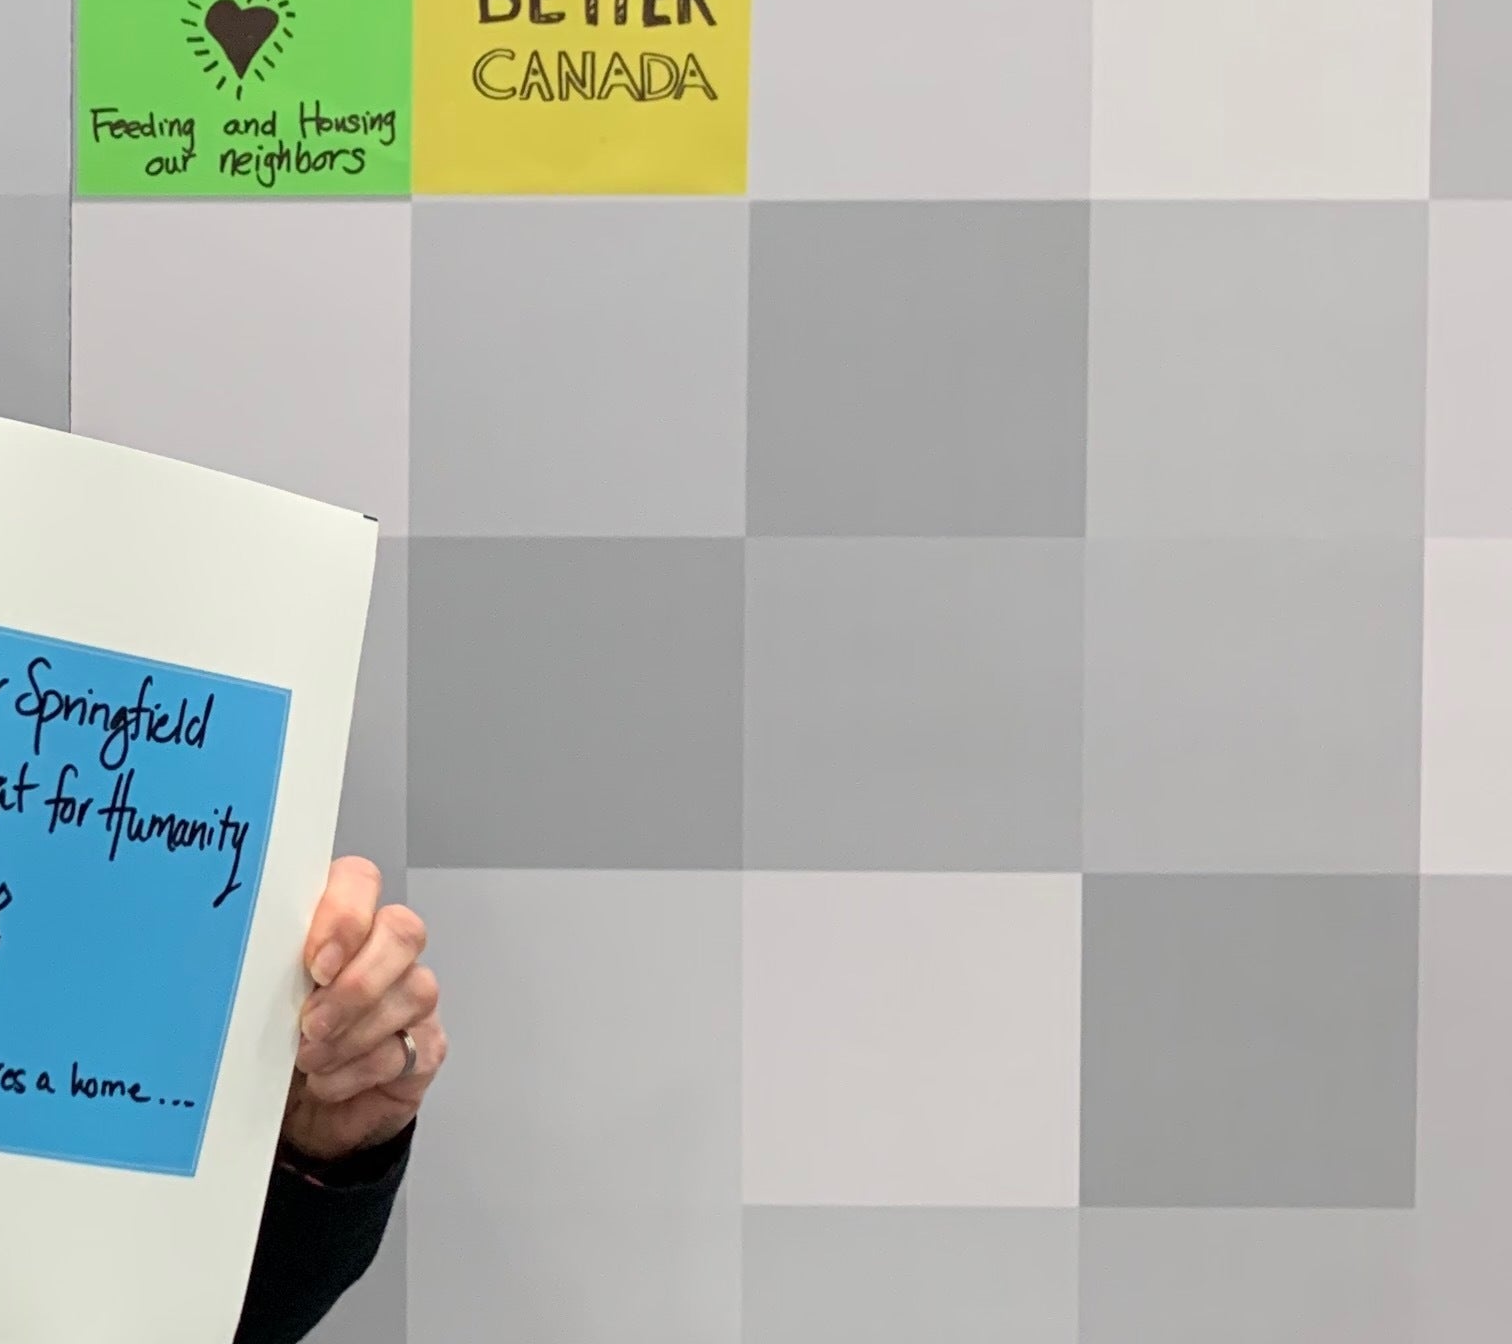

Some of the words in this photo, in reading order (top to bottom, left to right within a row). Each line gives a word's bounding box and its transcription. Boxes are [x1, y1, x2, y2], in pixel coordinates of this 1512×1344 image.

[472, 47, 719, 102] CANADA
[90, 107, 196, 152] Feeding
[223, 110, 277, 137] and
[299, 99, 396, 146] Housing
[145, 148, 197, 176] our
[219, 139, 366, 188] neighbors
[14, 656, 214, 769] Springfield
[44, 764, 93, 834] for
[97, 768, 250, 908] Humanity
[36, 1070, 55, 1094] a
